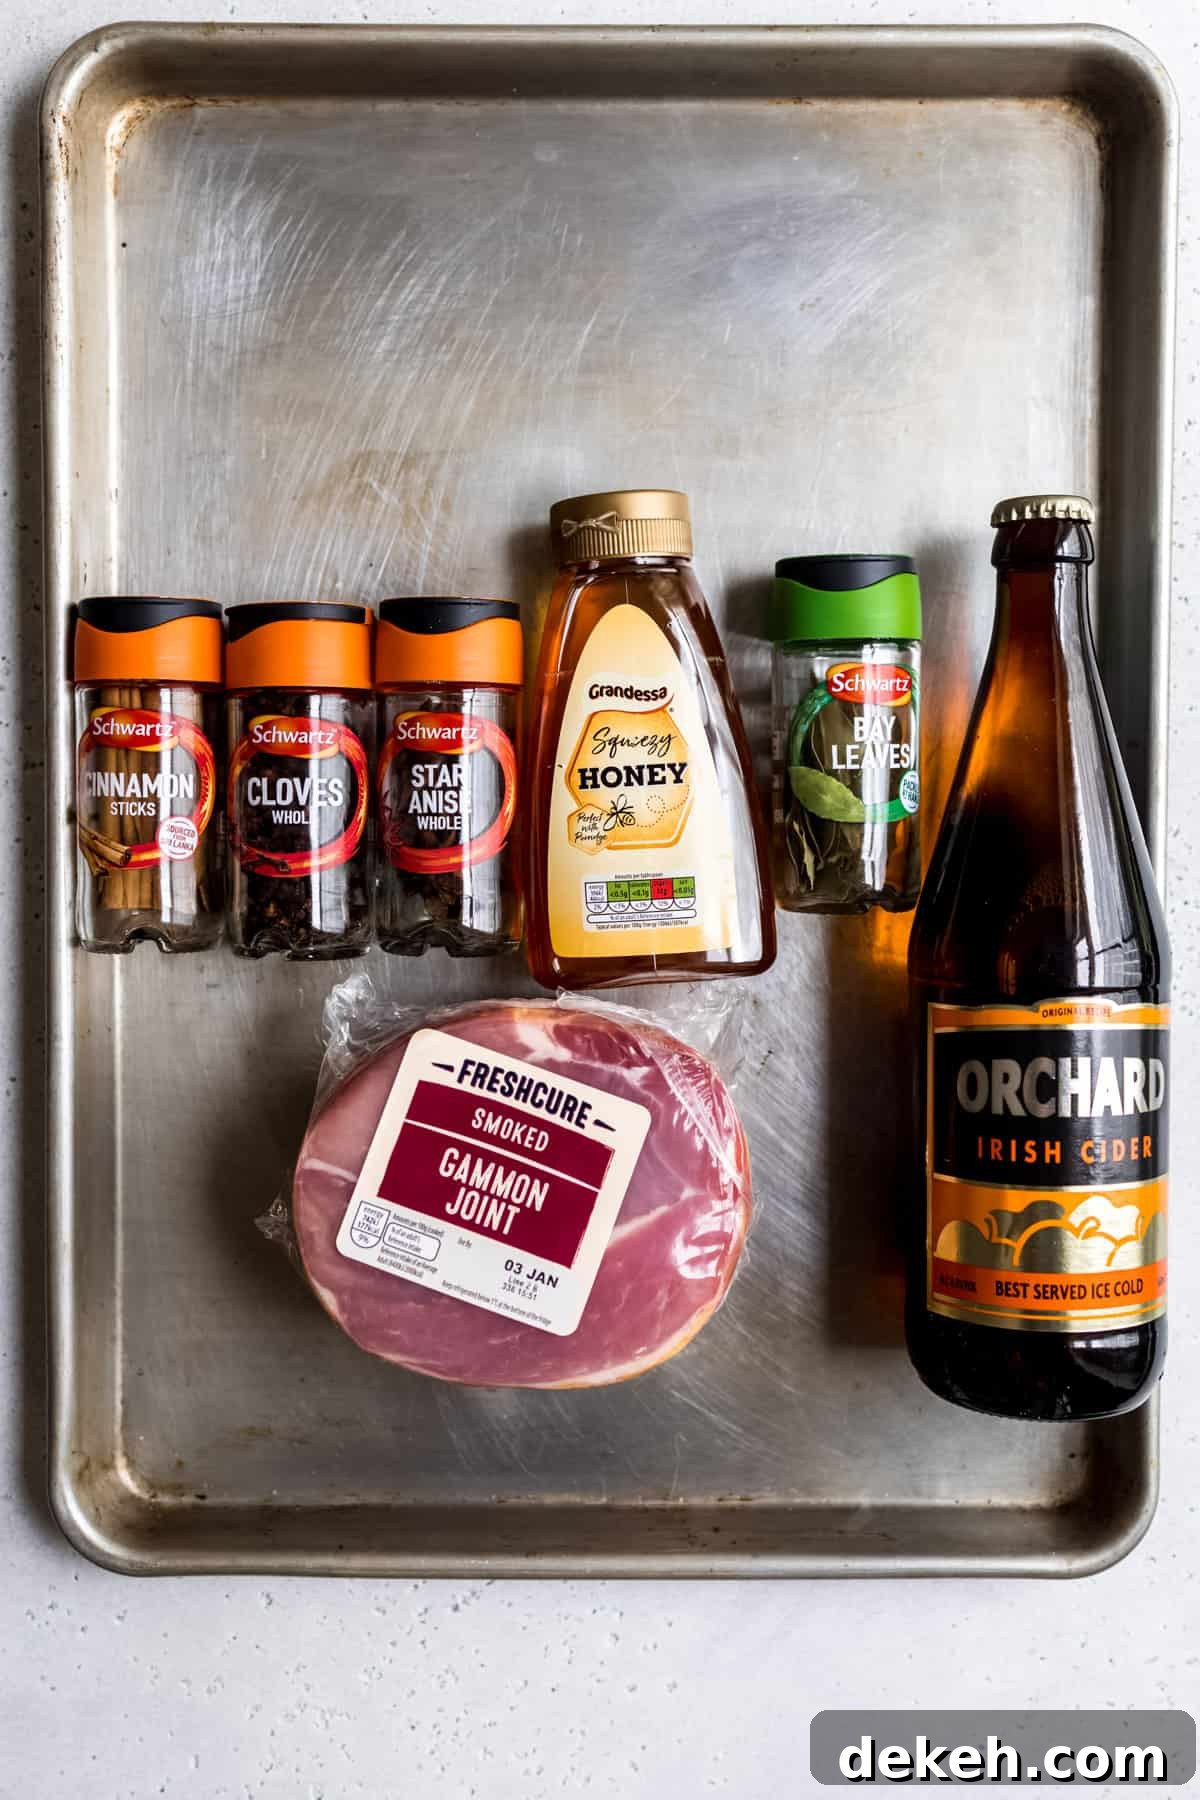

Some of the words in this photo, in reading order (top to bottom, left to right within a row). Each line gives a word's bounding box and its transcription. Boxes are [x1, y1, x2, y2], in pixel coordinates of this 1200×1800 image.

[589, 684, 668, 701] Grandessa
[831, 673, 909, 693] Schwartz
[92, 717, 174, 737] Schwartz
[252, 725, 335, 744] Schwartz
[397, 721, 478, 740] Schwartz
[854, 716, 896, 742] BAY
[831, 744, 911, 770] LEAVES
[85, 772, 194, 798] CINNAMON
[411, 764, 470, 788] STAR
[577, 762, 688, 790] HONEY
[247, 777, 344, 807] CLOVES
[110, 801, 156, 817] STICKS
[272, 810, 314, 825] WHOL
[416, 815, 464, 831] WHOLE
[457, 1058, 593, 1130] FRESHCURE
[957, 1057, 1165, 1118] ORCHARD
[471, 1107, 550, 1152] SMOKED
[977, 1136, 1062, 1164] IRISH
[1080, 1135, 1153, 1165] CIDER
[439, 1147, 550, 1212] GAMMON
[445, 1187, 521, 1236] JOINT
[504, 1259, 523, 1274] 03
[526, 1268, 559, 1289] JAN
[995, 1280, 1029, 1299] BEST
[1033, 1279, 1087, 1300] SERVED
[1091, 1280, 1111, 1298] ICE
[1114, 1278, 1144, 1298] COLD
